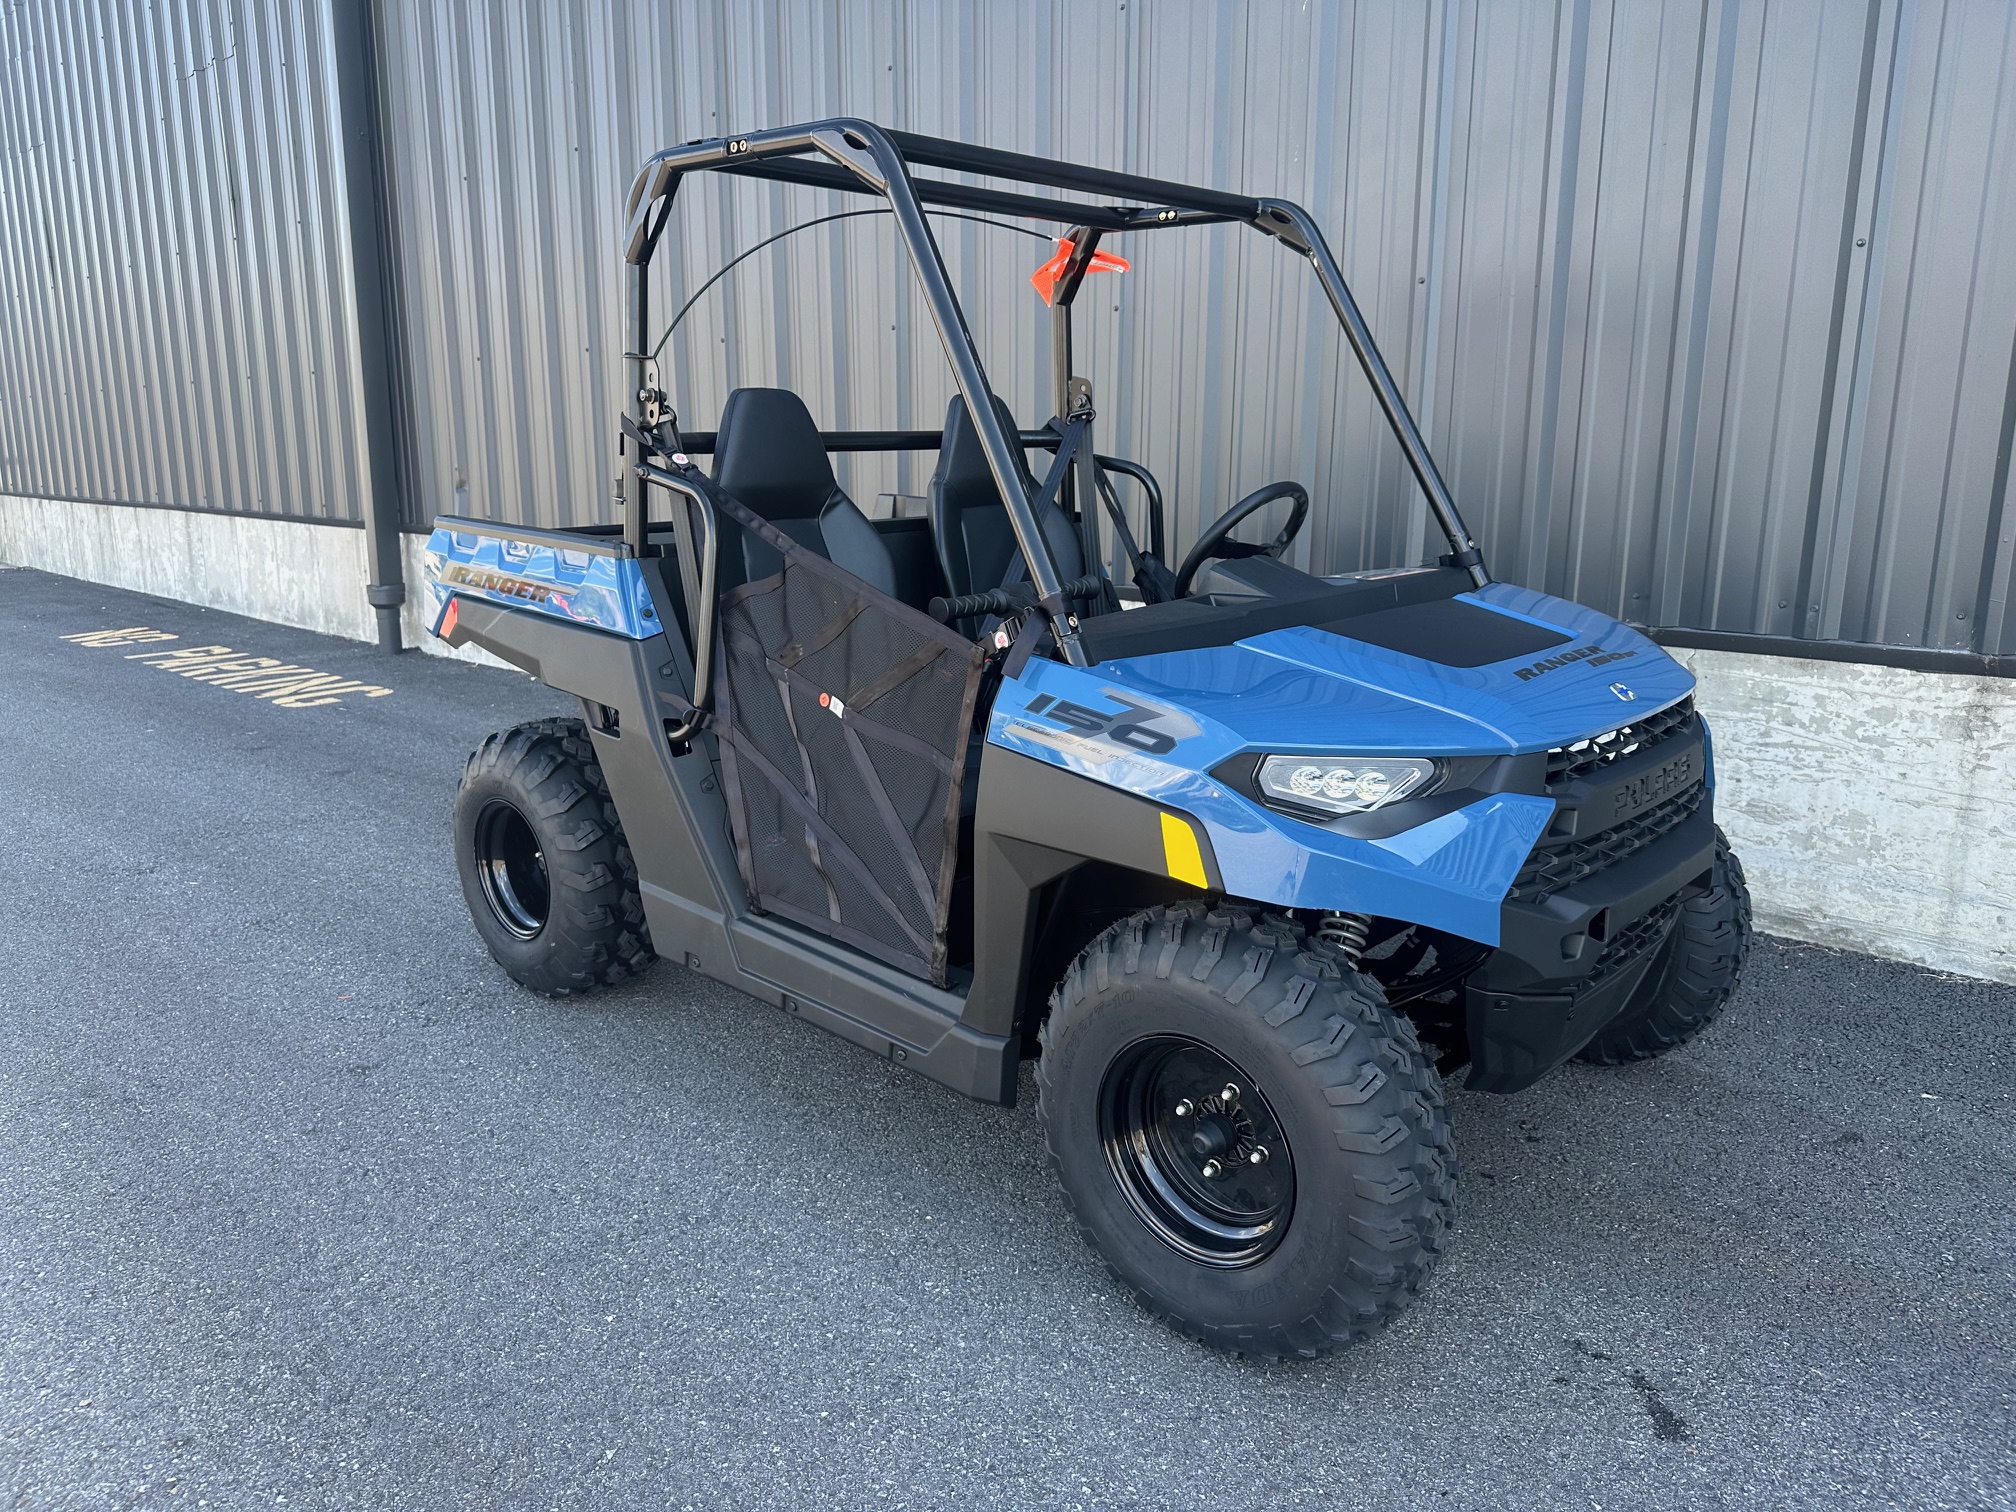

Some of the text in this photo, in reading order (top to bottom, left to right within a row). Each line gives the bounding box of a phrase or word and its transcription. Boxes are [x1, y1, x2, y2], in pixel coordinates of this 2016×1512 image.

[448, 566, 551, 604] RANGER
[58, 627, 394, 708] NO PARKING
[1513, 645, 1606, 682] RANGER
[1022, 692, 1178, 756] 150
[1613, 753, 1691, 818] POLARIS
